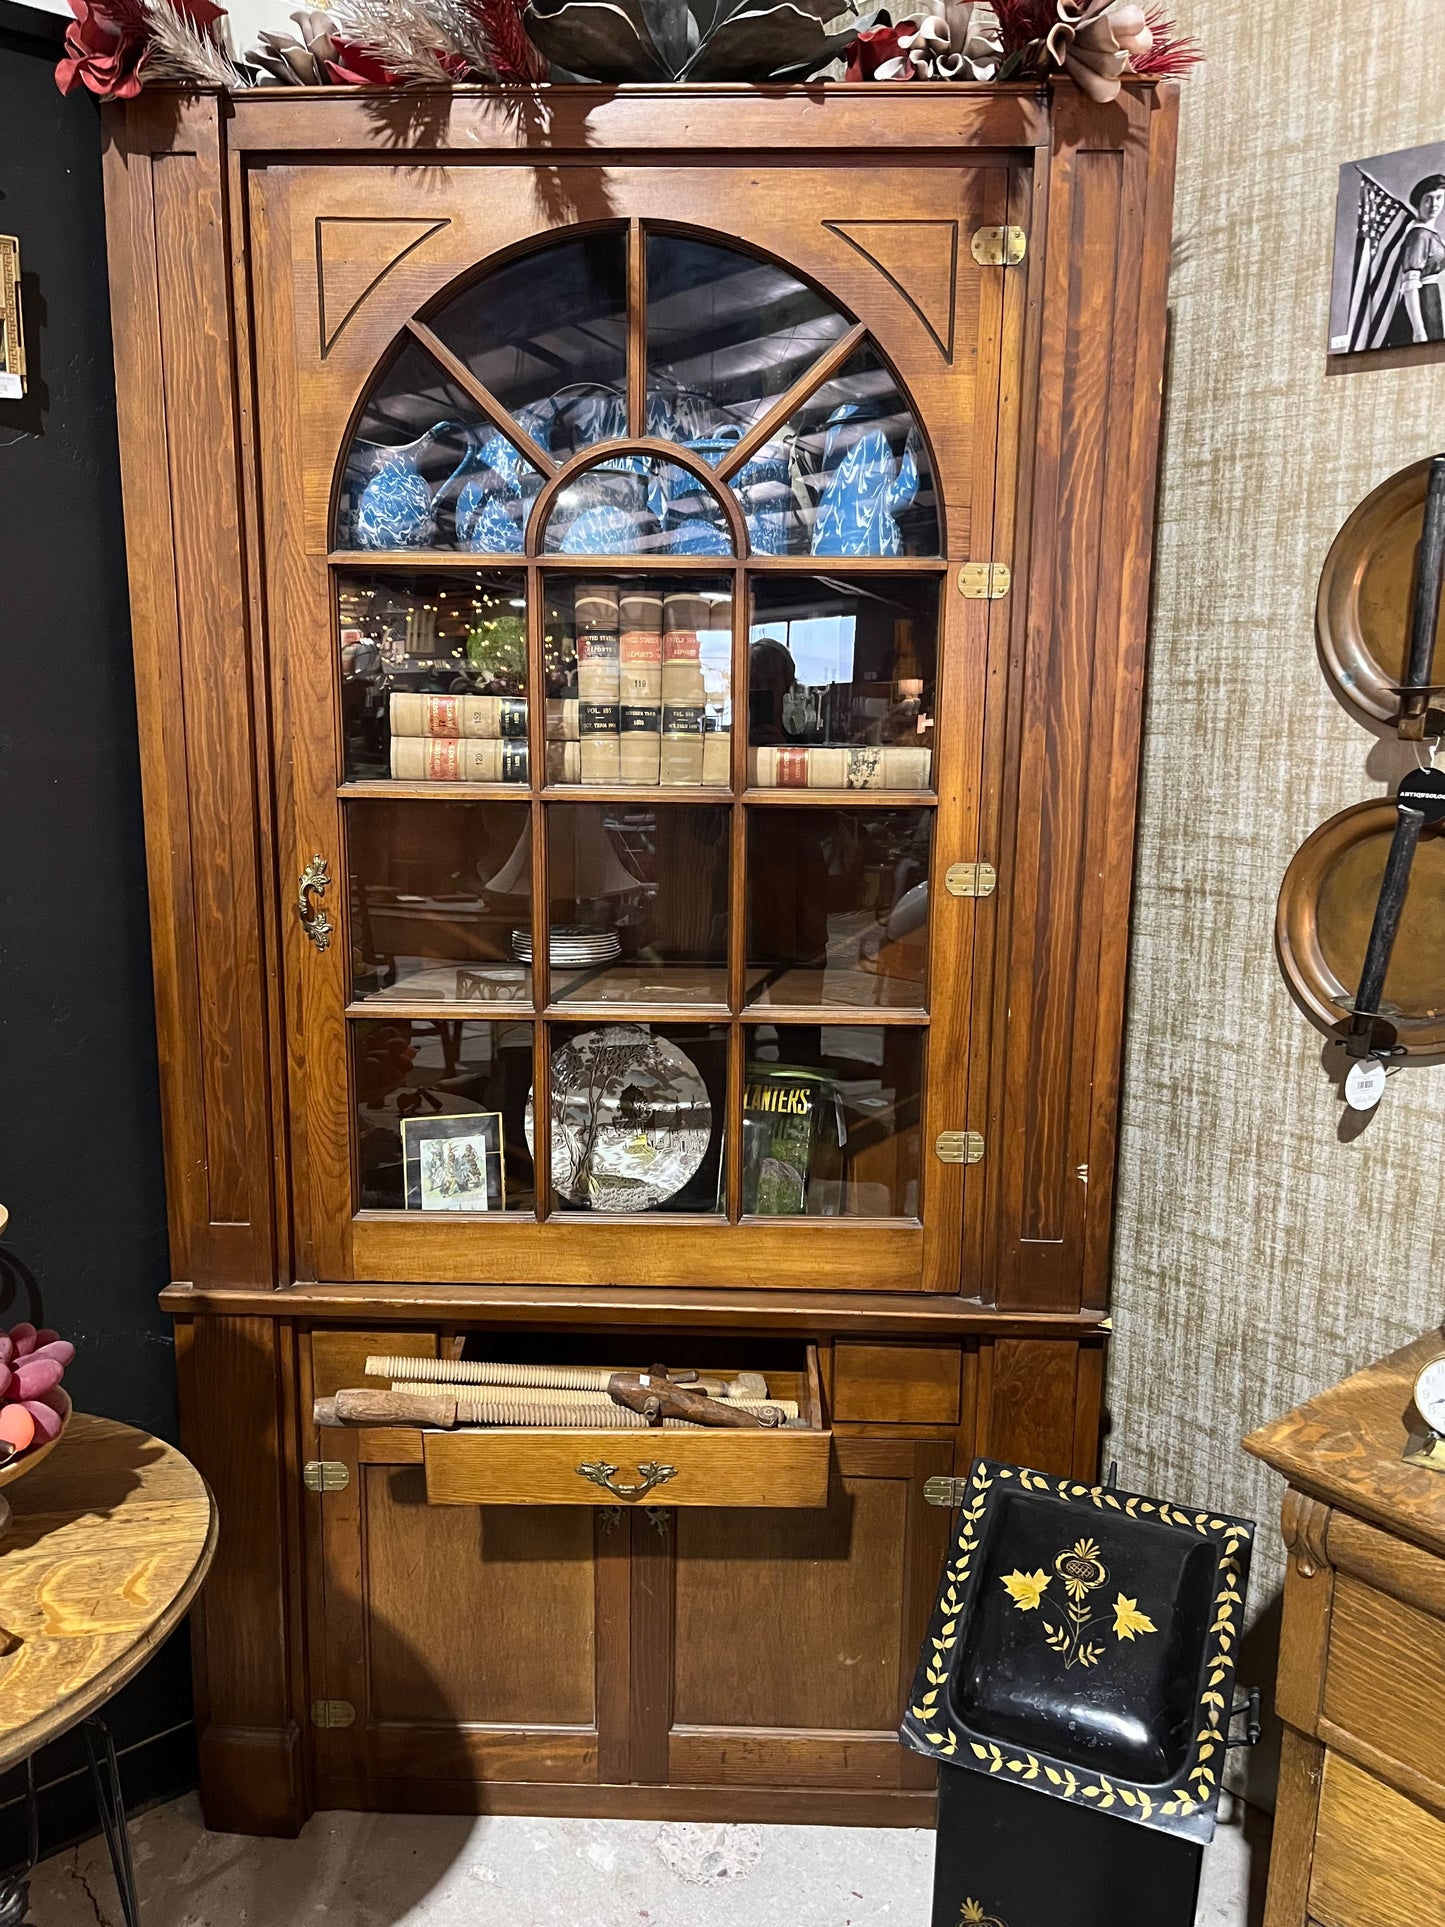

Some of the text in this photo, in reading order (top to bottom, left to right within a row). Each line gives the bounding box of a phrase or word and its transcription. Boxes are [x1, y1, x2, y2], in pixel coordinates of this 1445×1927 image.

[634, 679, 646, 688] 119
[474, 711, 482, 724] 152
[475, 753, 484, 766] 120
